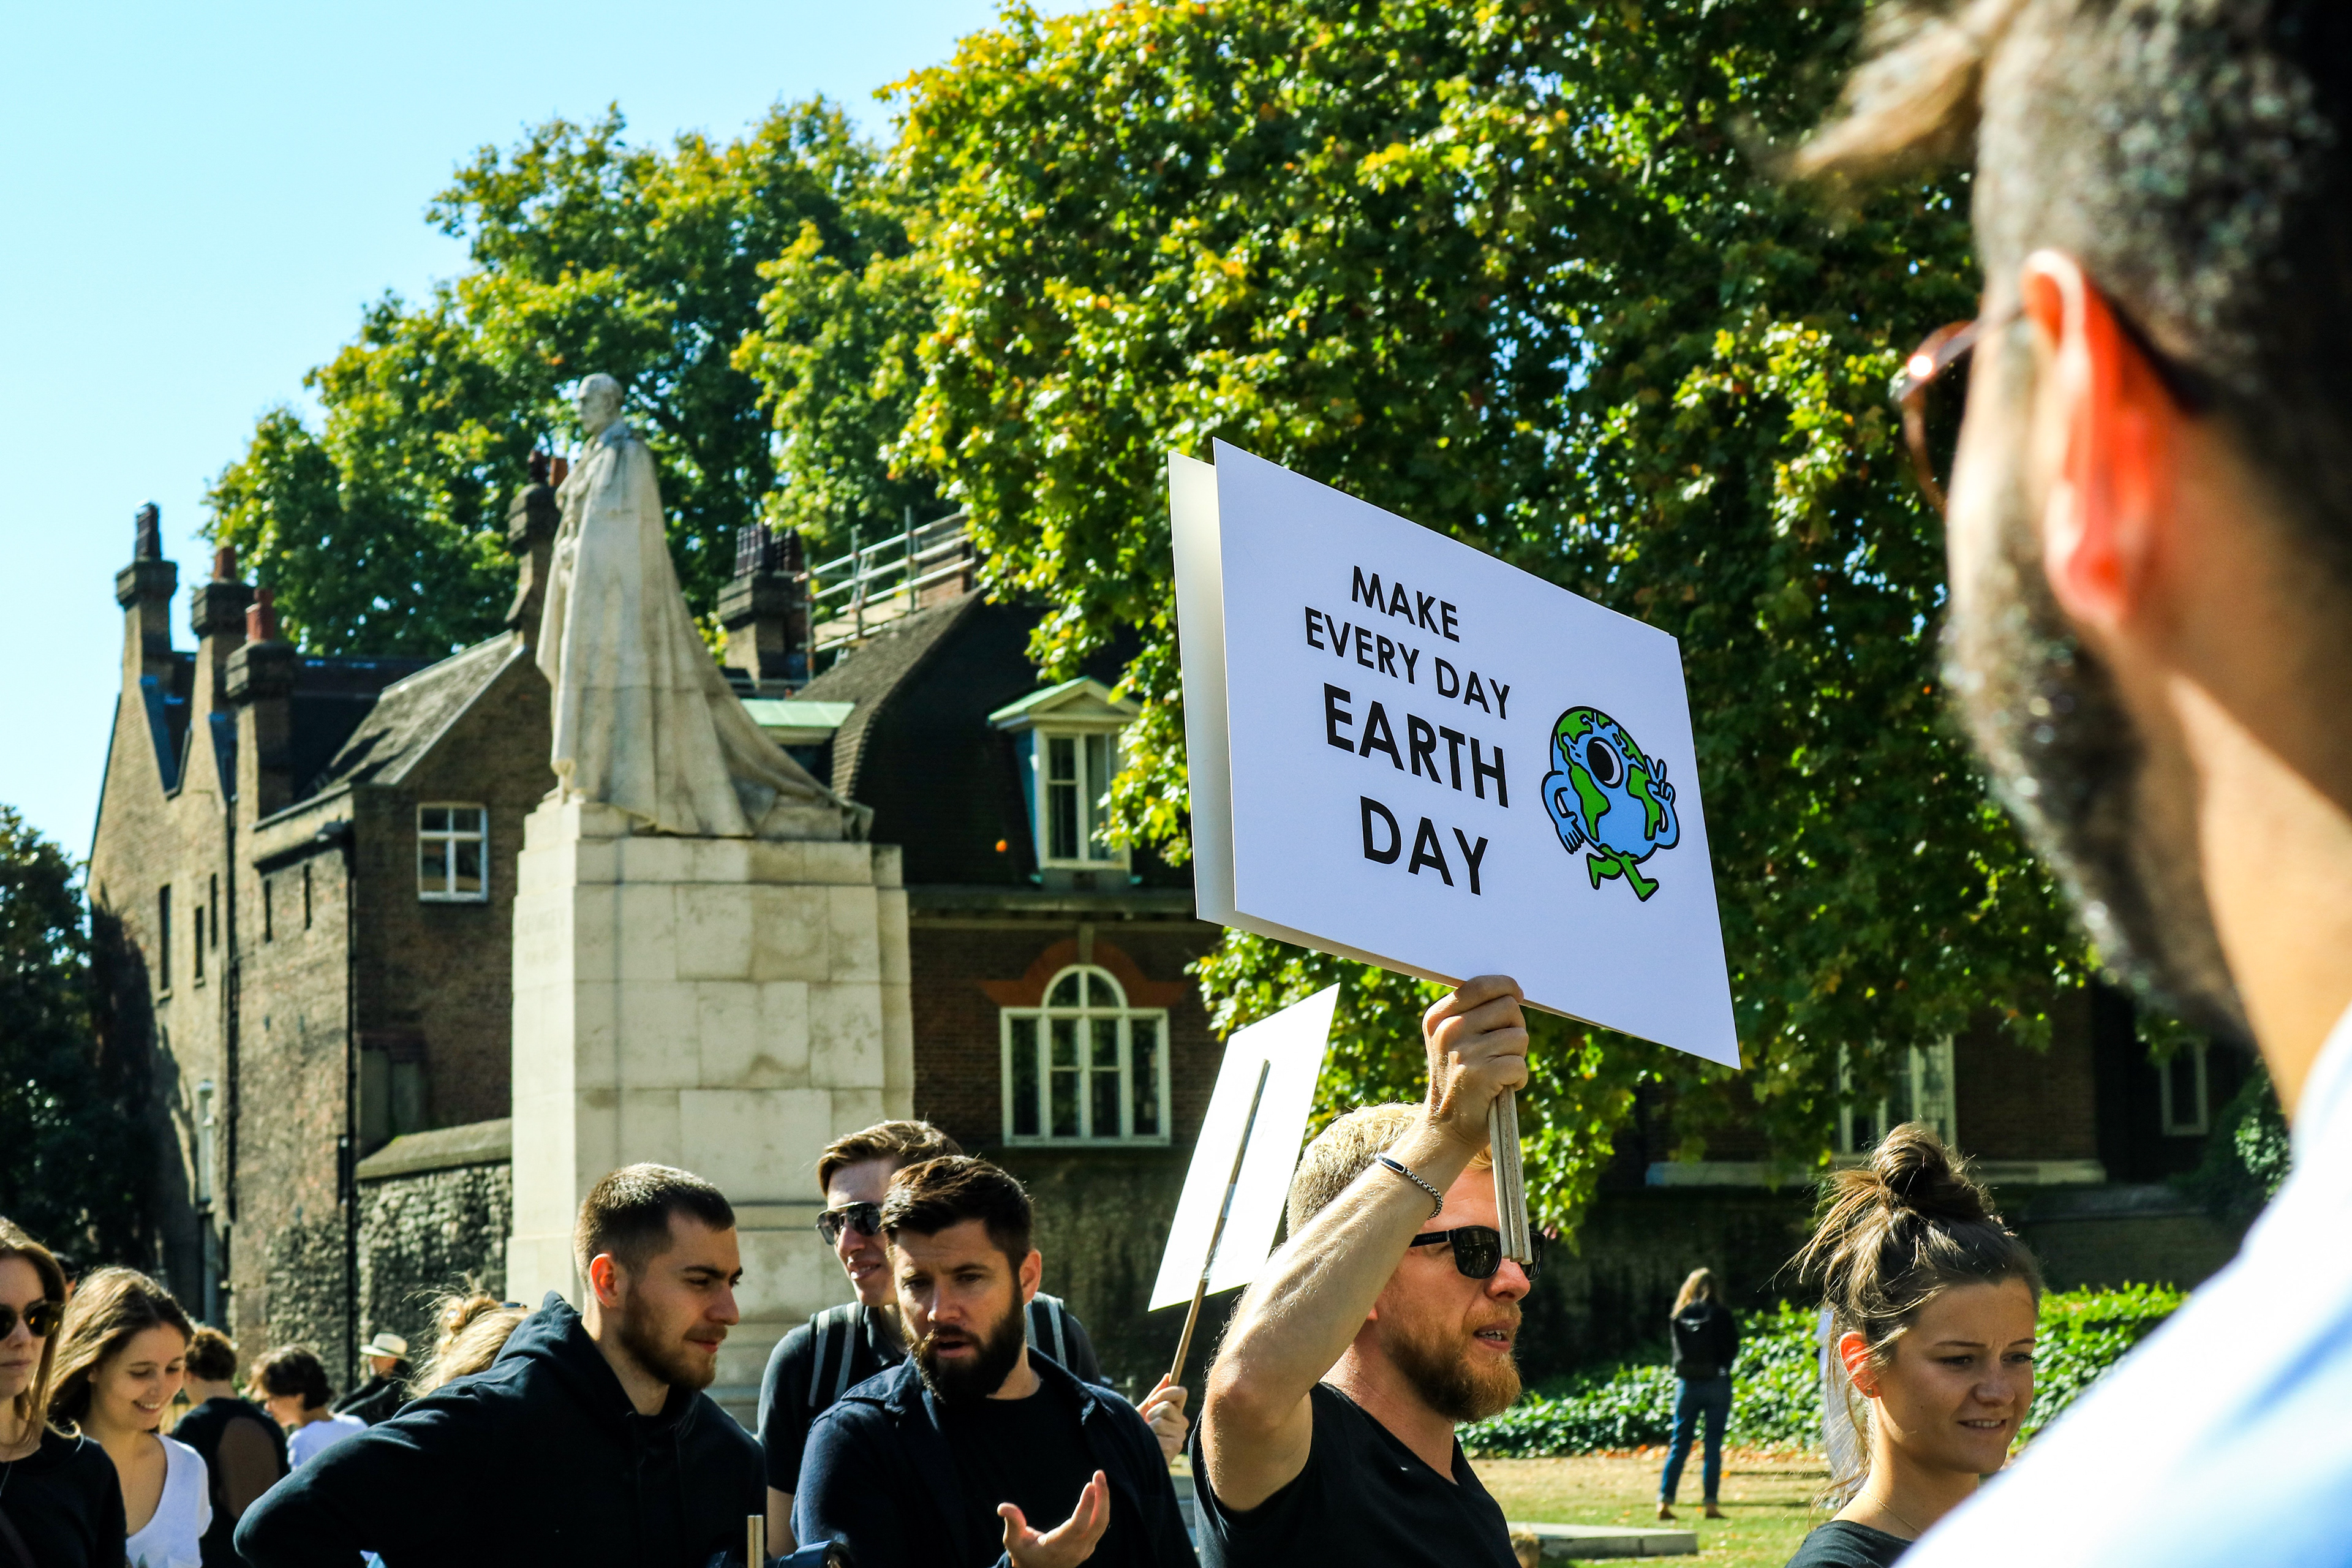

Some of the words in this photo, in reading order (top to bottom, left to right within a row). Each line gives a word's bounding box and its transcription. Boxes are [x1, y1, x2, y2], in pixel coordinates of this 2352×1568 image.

[1351, 565, 1460, 643] MAKE
[1305, 606, 1420, 685] EVERY
[1434, 656, 1510, 720] DAY
[1323, 682, 1509, 809] EARTH
[1360, 795, 1489, 896] DAY
